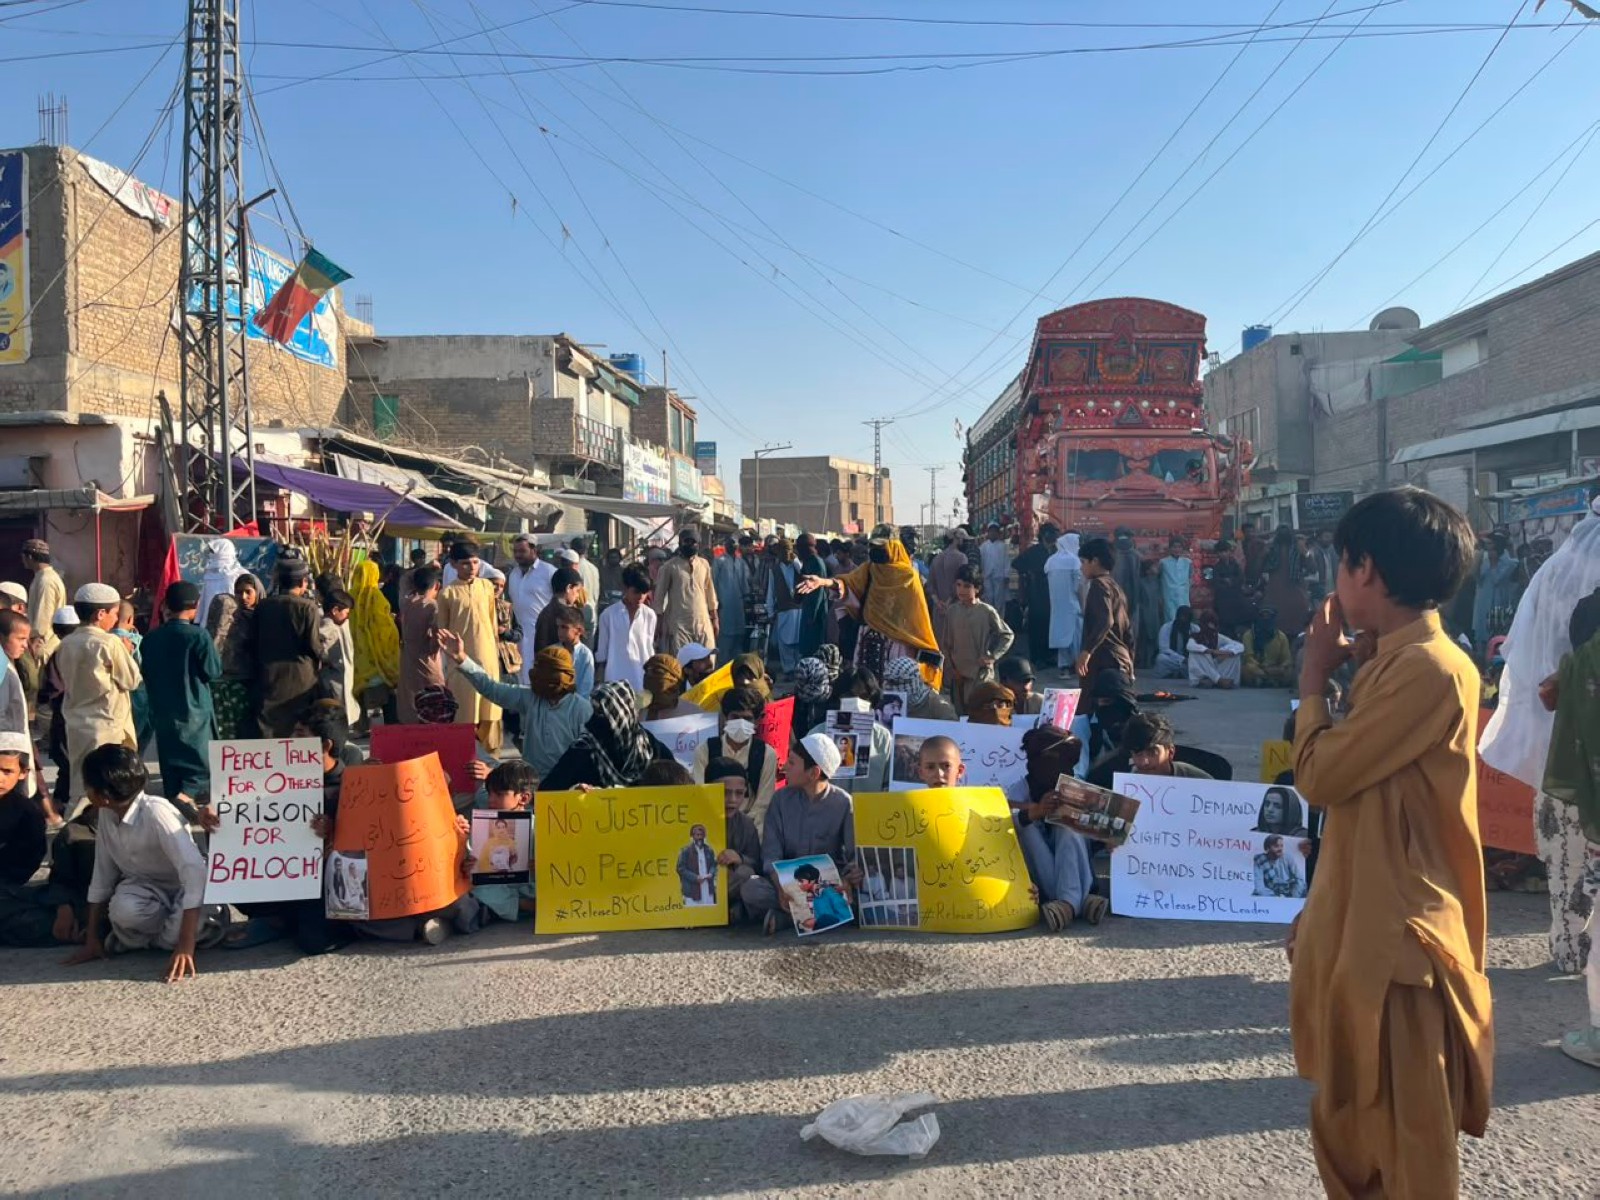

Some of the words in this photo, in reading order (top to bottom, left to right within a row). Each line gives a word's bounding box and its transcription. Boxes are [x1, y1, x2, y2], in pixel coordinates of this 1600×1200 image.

[221, 745, 273, 771] PEACE
[278, 740, 321, 766] TALK
[228, 776, 256, 796] FOR
[595, 797, 689, 834] JUSTICE
[243, 827, 286, 846] FOR
[1187, 828, 1252, 851] PAKISTAN
[599, 853, 669, 882] PEACE
